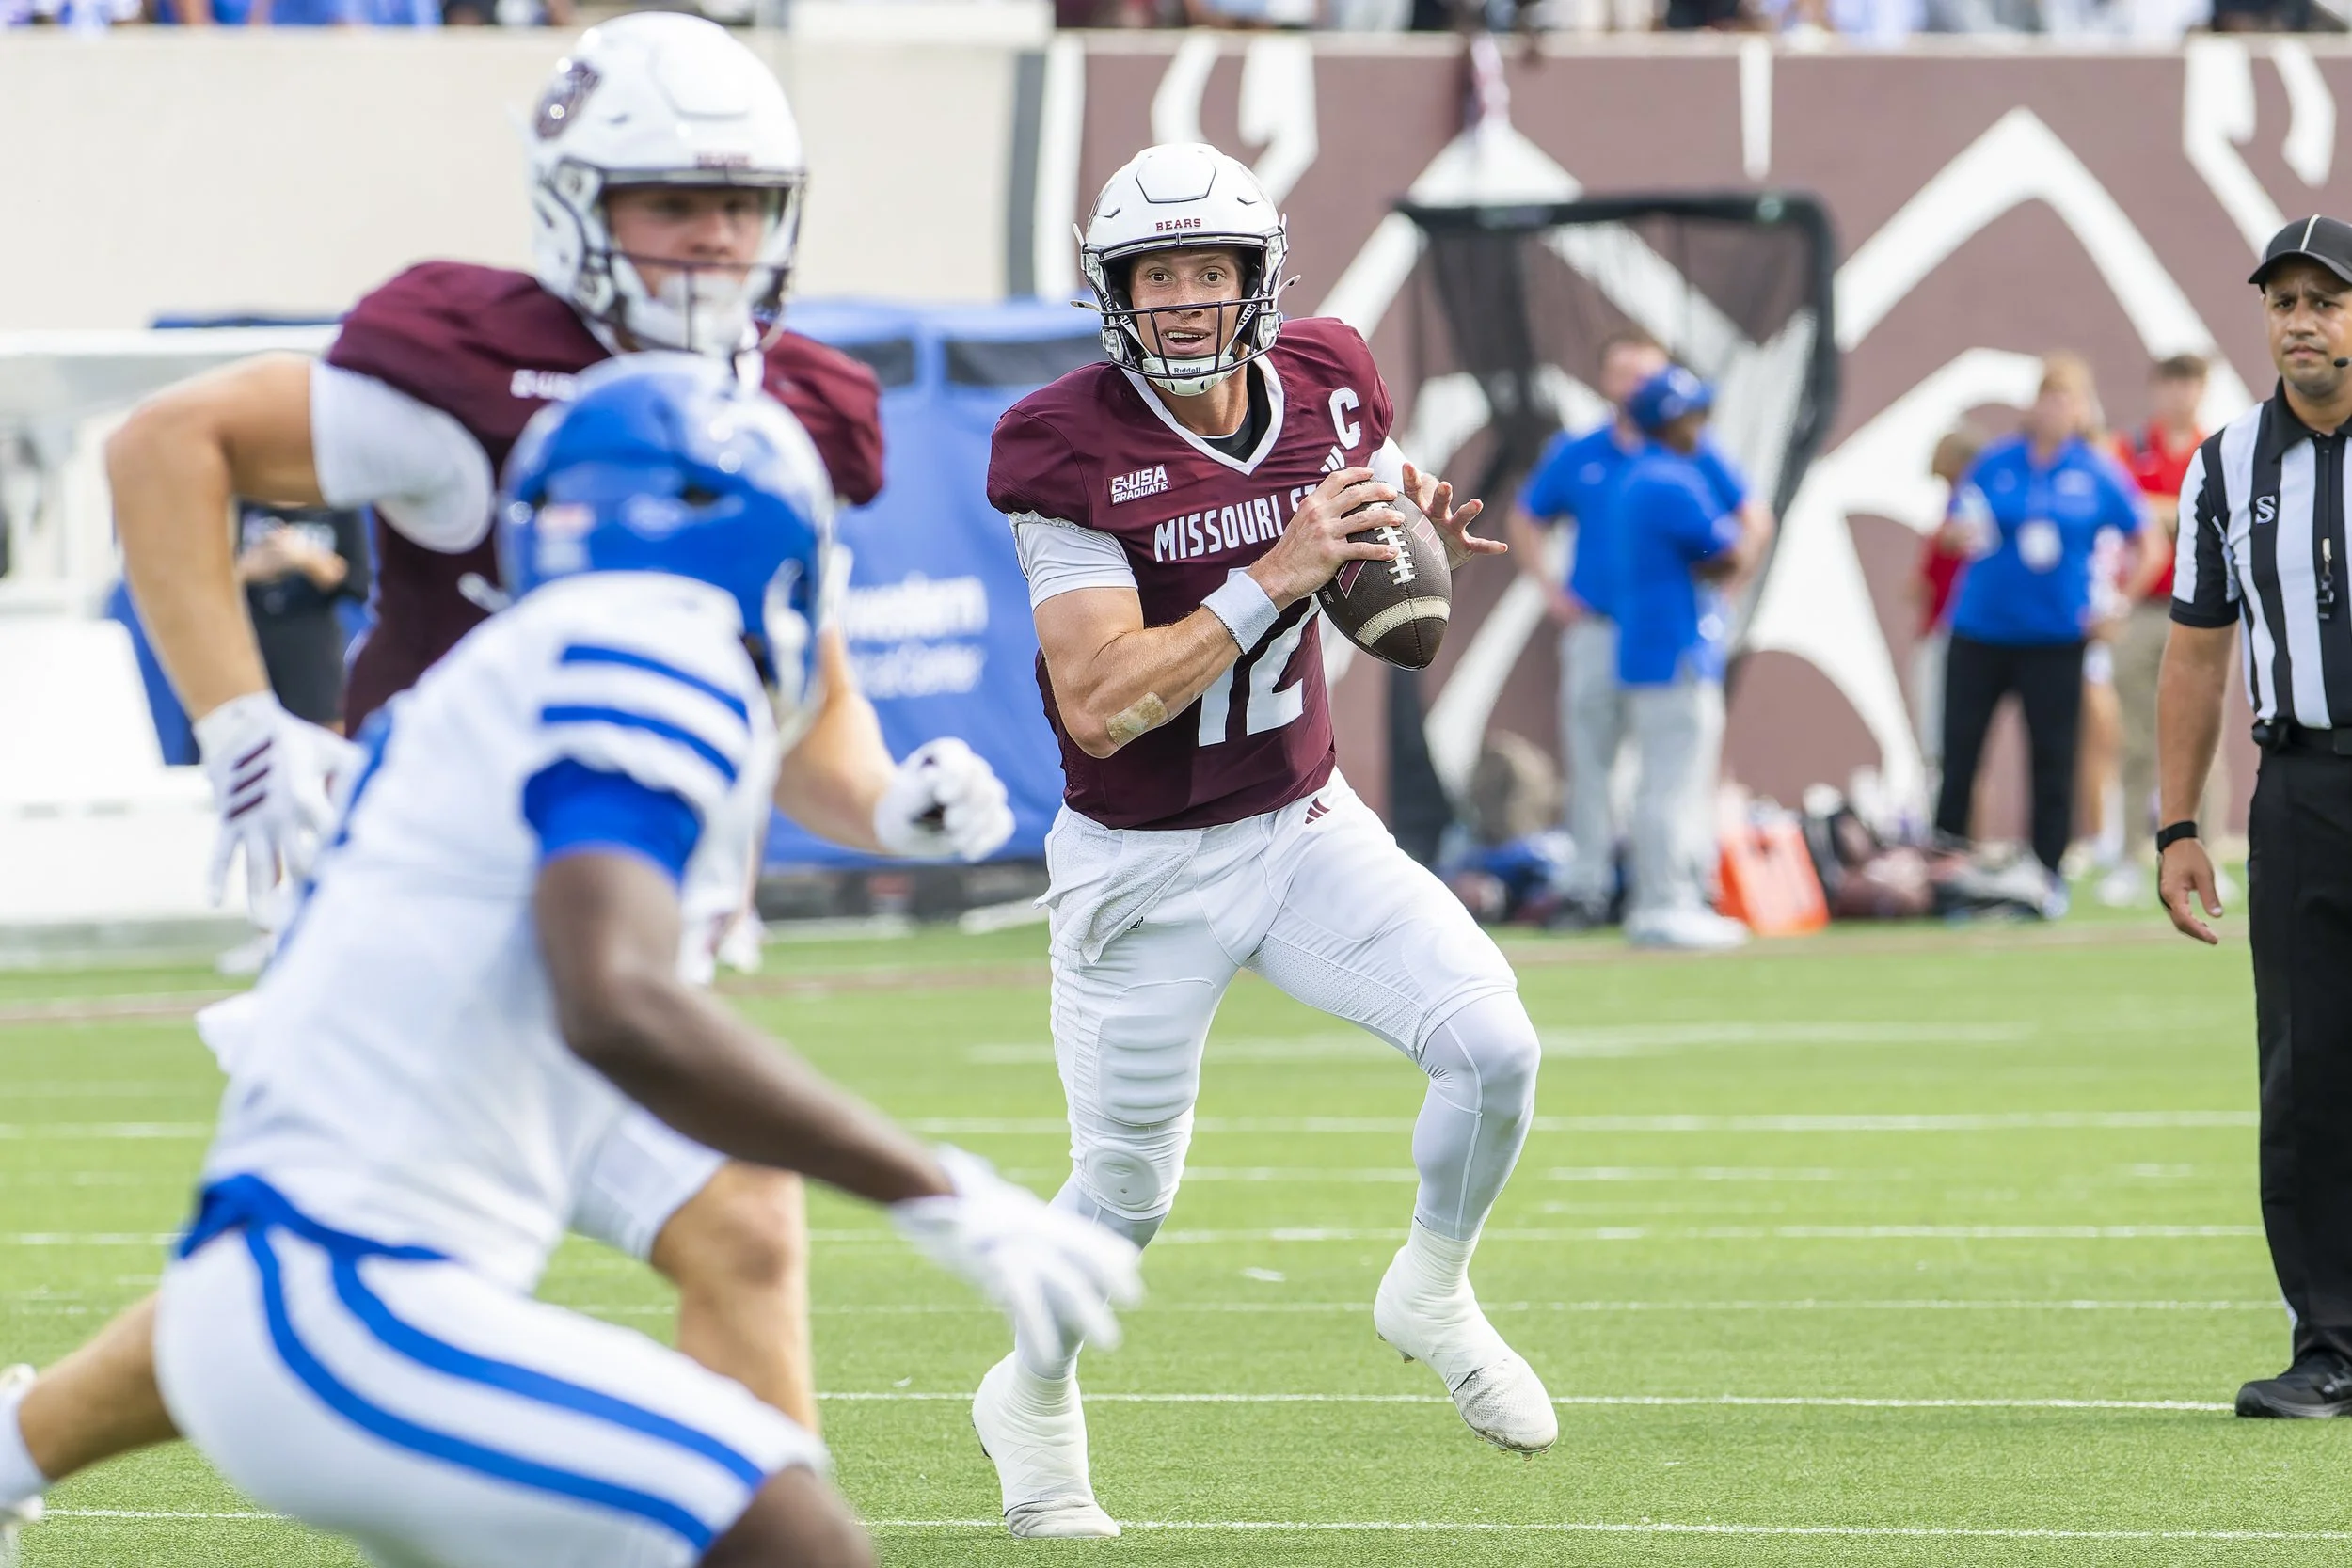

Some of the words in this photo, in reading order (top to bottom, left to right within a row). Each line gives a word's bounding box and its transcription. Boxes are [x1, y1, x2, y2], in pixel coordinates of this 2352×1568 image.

[1155, 217, 1201, 231] BEARS
[1328, 386, 1361, 450] C
[1113, 480, 1168, 503] GRADUATE
[2254, 494, 2276, 525] S
[1153, 494, 1284, 562] MISSOURI
